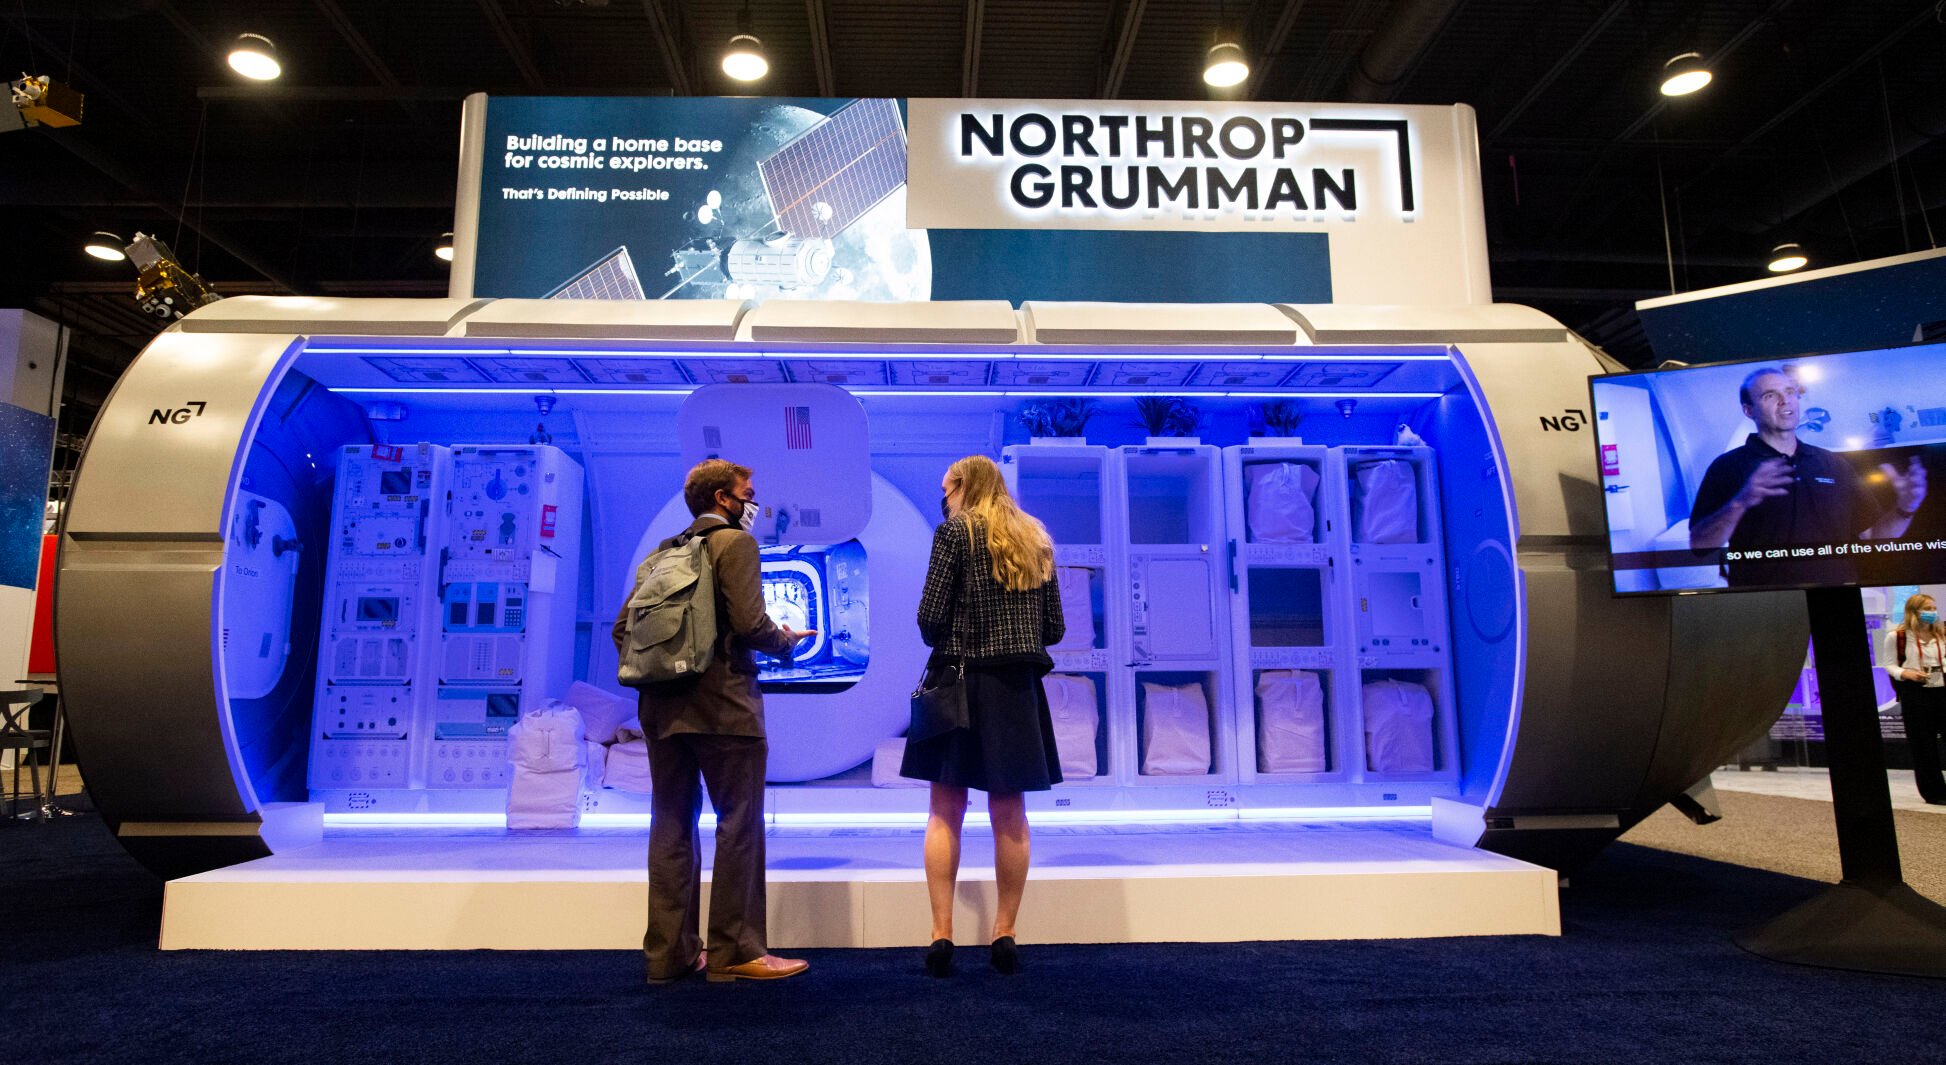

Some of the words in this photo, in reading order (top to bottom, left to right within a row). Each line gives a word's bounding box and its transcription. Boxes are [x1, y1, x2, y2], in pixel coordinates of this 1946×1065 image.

[506, 134, 588, 154] Building
[593, 137, 606, 151] a
[612, 136, 669, 152] home
[674, 137, 723, 152] base
[961, 113, 1305, 160] NORTHROP
[505, 152, 533, 168] for
[538, 152, 604, 169] cosmic
[609, 154, 709, 172] explorers.
[502, 187, 544, 200] That's
[547, 187, 608, 202] Defining
[611, 188, 670, 201] Possible
[1010, 163, 1357, 211] GRUMMAN
[147, 407, 192, 425] NG
[1539, 415, 1580, 432] NG
[1726, 551, 1742, 560] so
[1744, 550, 1763, 559] we
[1765, 549, 1788, 558] can
[1791, 547, 1815, 557] use
[1817, 544, 1833, 555] all
[1835, 543, 1848, 554] of
[1851, 543, 1872, 553] the
[1875, 541, 1923, 552] volume
[235, 565, 242, 575] To
